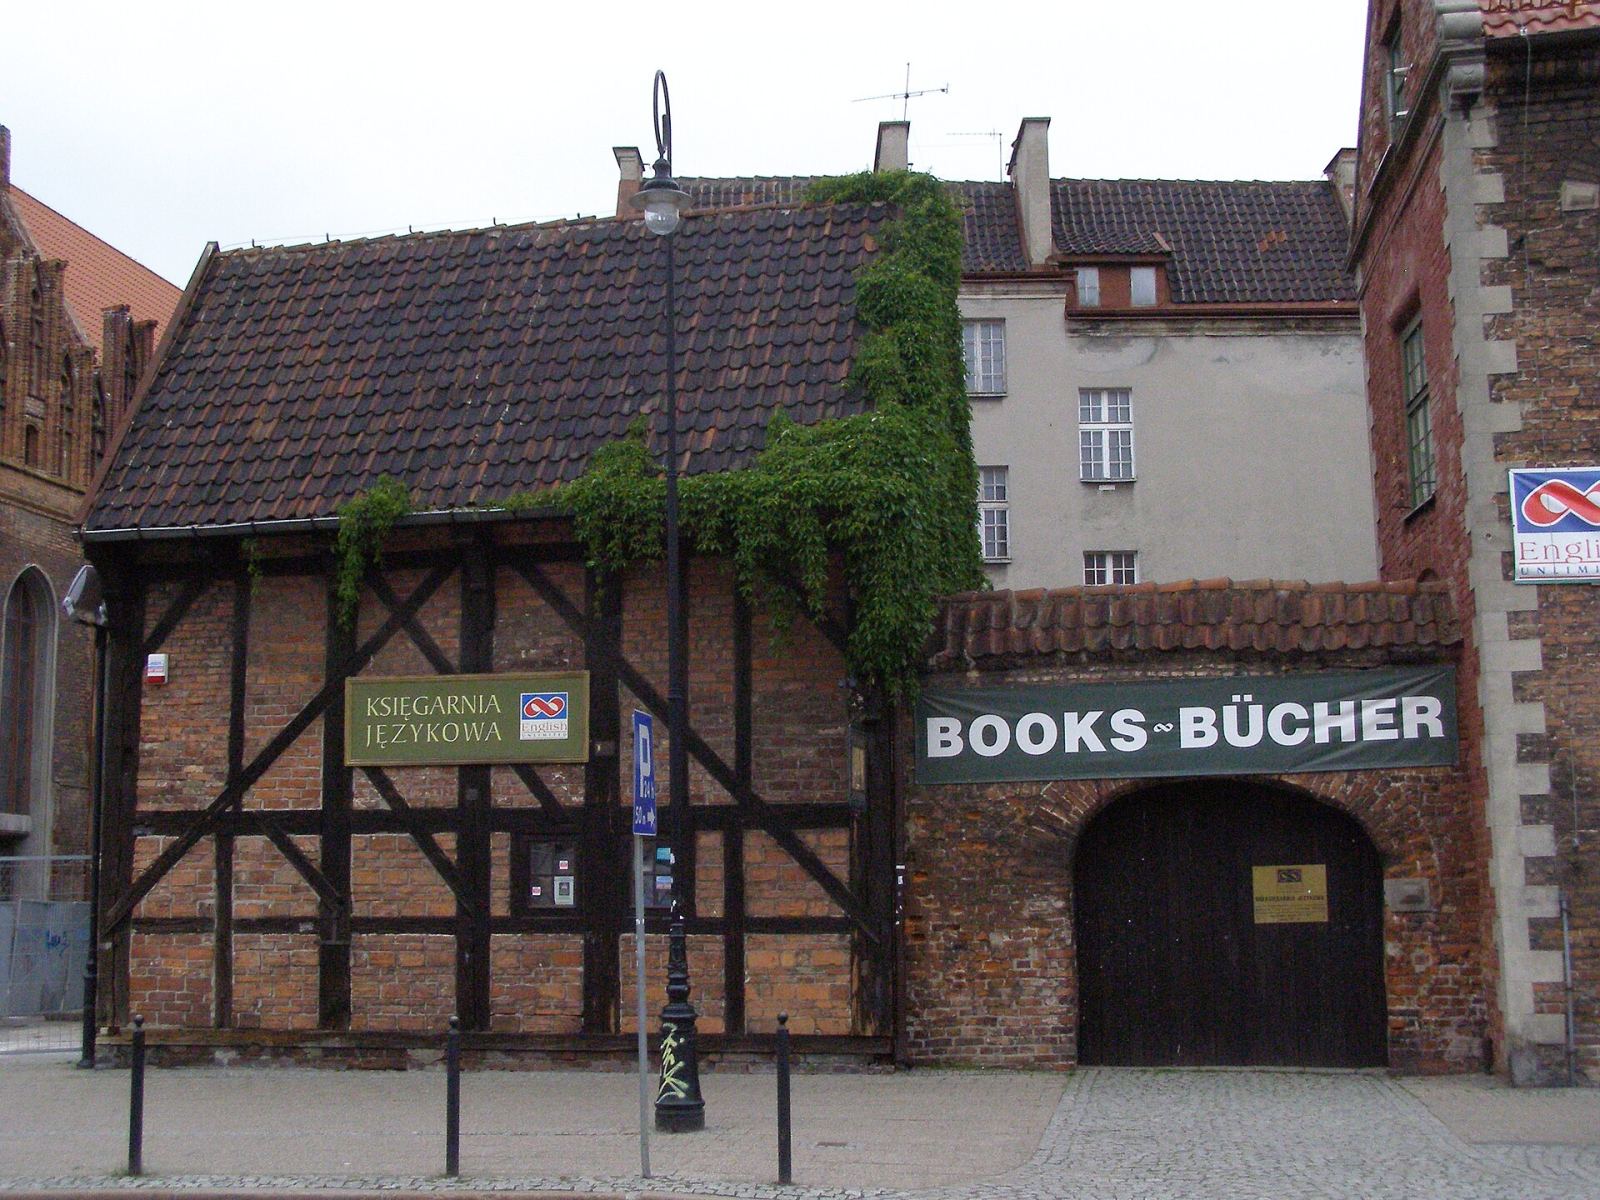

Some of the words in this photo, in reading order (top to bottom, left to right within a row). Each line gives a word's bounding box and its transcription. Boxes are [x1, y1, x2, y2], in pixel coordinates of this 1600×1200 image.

[367, 694, 502, 721] KSIĘGARNIA
[366, 722, 502, 749] JĘZYKOWA
[522, 721, 567, 733] English
[927, 708, 1148, 757] BOOKS
[1179, 694, 1445, 749] BÜCHER
